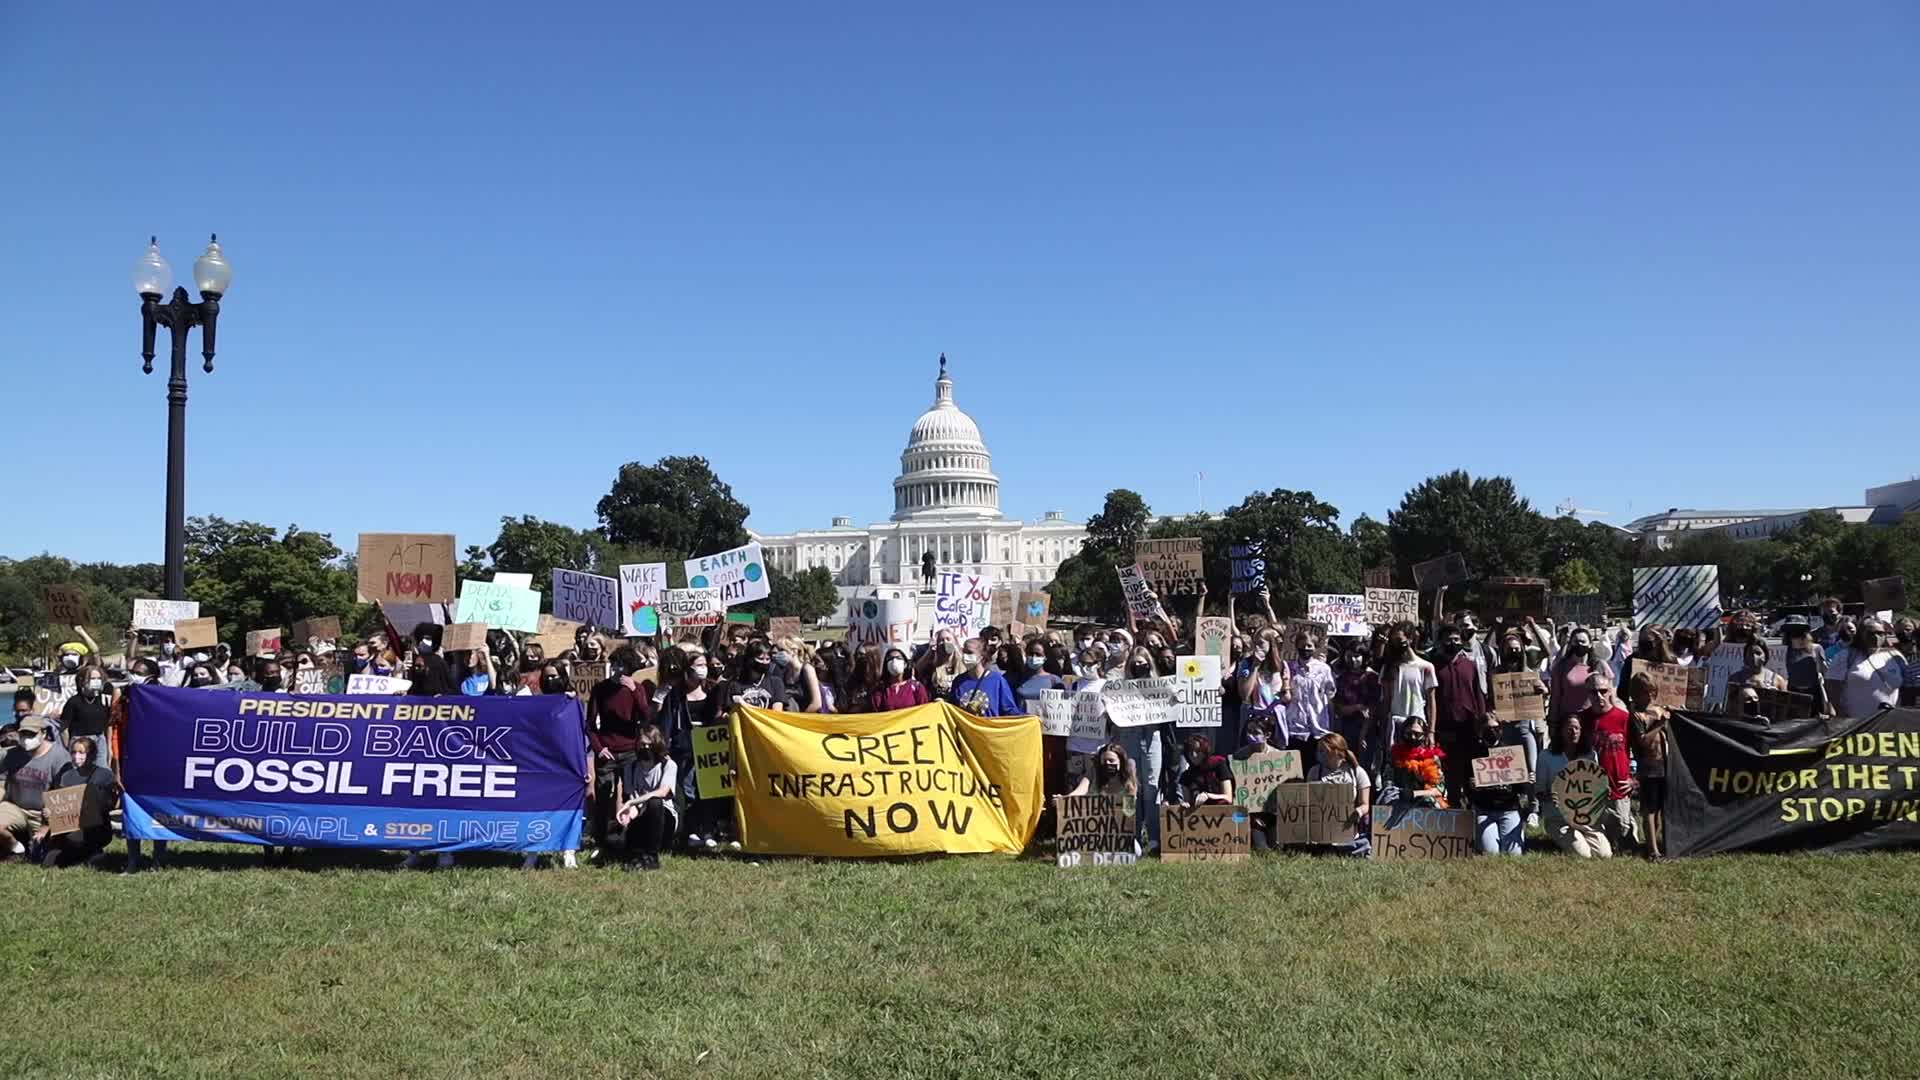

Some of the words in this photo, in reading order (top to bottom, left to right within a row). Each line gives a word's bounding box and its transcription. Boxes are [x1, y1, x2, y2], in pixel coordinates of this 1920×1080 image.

[388, 543, 433, 566] ACT
[700, 550, 747, 572] EARTH
[622, 567, 661, 584] WAKE
[1143, 560, 1191, 571] BOUGHT
[1173, 569, 1198, 578] NOT
[385, 572, 433, 599] NOW
[561, 571, 615, 595] CLIMATE
[937, 573, 961, 596] IF
[561, 585, 614, 610] JUSTICE
[660, 589, 684, 601] THE
[686, 588, 719, 600] WRONG
[1368, 590, 1417, 603] CLIMATE
[565, 603, 603, 625] NOW
[662, 601, 711, 613] amazon
[1367, 602, 1417, 614] JUSTICE
[849, 619, 913, 644] PLANET
[296, 669, 325, 684] SAVE
[351, 678, 389, 692] IT'S
[1104, 680, 1121, 692] NO
[571, 680, 596, 694] YOU
[1177, 688, 1222, 705] CLIMATE
[239, 698, 389, 720] PRESIDENT
[393, 704, 476, 721] BIDEN:
[1178, 706, 1222, 723] JUSTICE
[192, 718, 352, 756] BUILD
[363, 724, 513, 760] BACK
[821, 723, 965, 767] GREEN
[1825, 731, 1920, 760] BIDEN
[1475, 756, 1514, 771] STOP
[1557, 759, 1608, 780] PLANT
[184, 756, 368, 794] FOSSIL
[381, 762, 518, 798] FREE
[1254, 774, 1284, 785] over
[1516, 768, 1526, 781] 3
[1708, 768, 1819, 795] HONOR
[1826, 764, 1892, 790] THE
[1898, 766, 1919, 791] T
[1564, 779, 1593, 794] ME
[844, 800, 974, 839] NOW
[1780, 797, 1866, 823] STOP
[1872, 799, 1920, 823] LIN
[203, 815, 264, 831] DOWN
[265, 815, 359, 841] DAPL
[364, 824, 379, 836] &
[384, 822, 433, 836] STOP
[437, 820, 520, 844] LINE
[526, 820, 552, 842] 3
[1062, 816, 1136, 836] ATIONAL
[1167, 809, 1225, 832] New
[1058, 834, 1137, 853] COOPERATION
[1375, 833, 1407, 857] The
[1409, 833, 1476, 858] SYSTEM
[1059, 852, 1081, 867] OR
